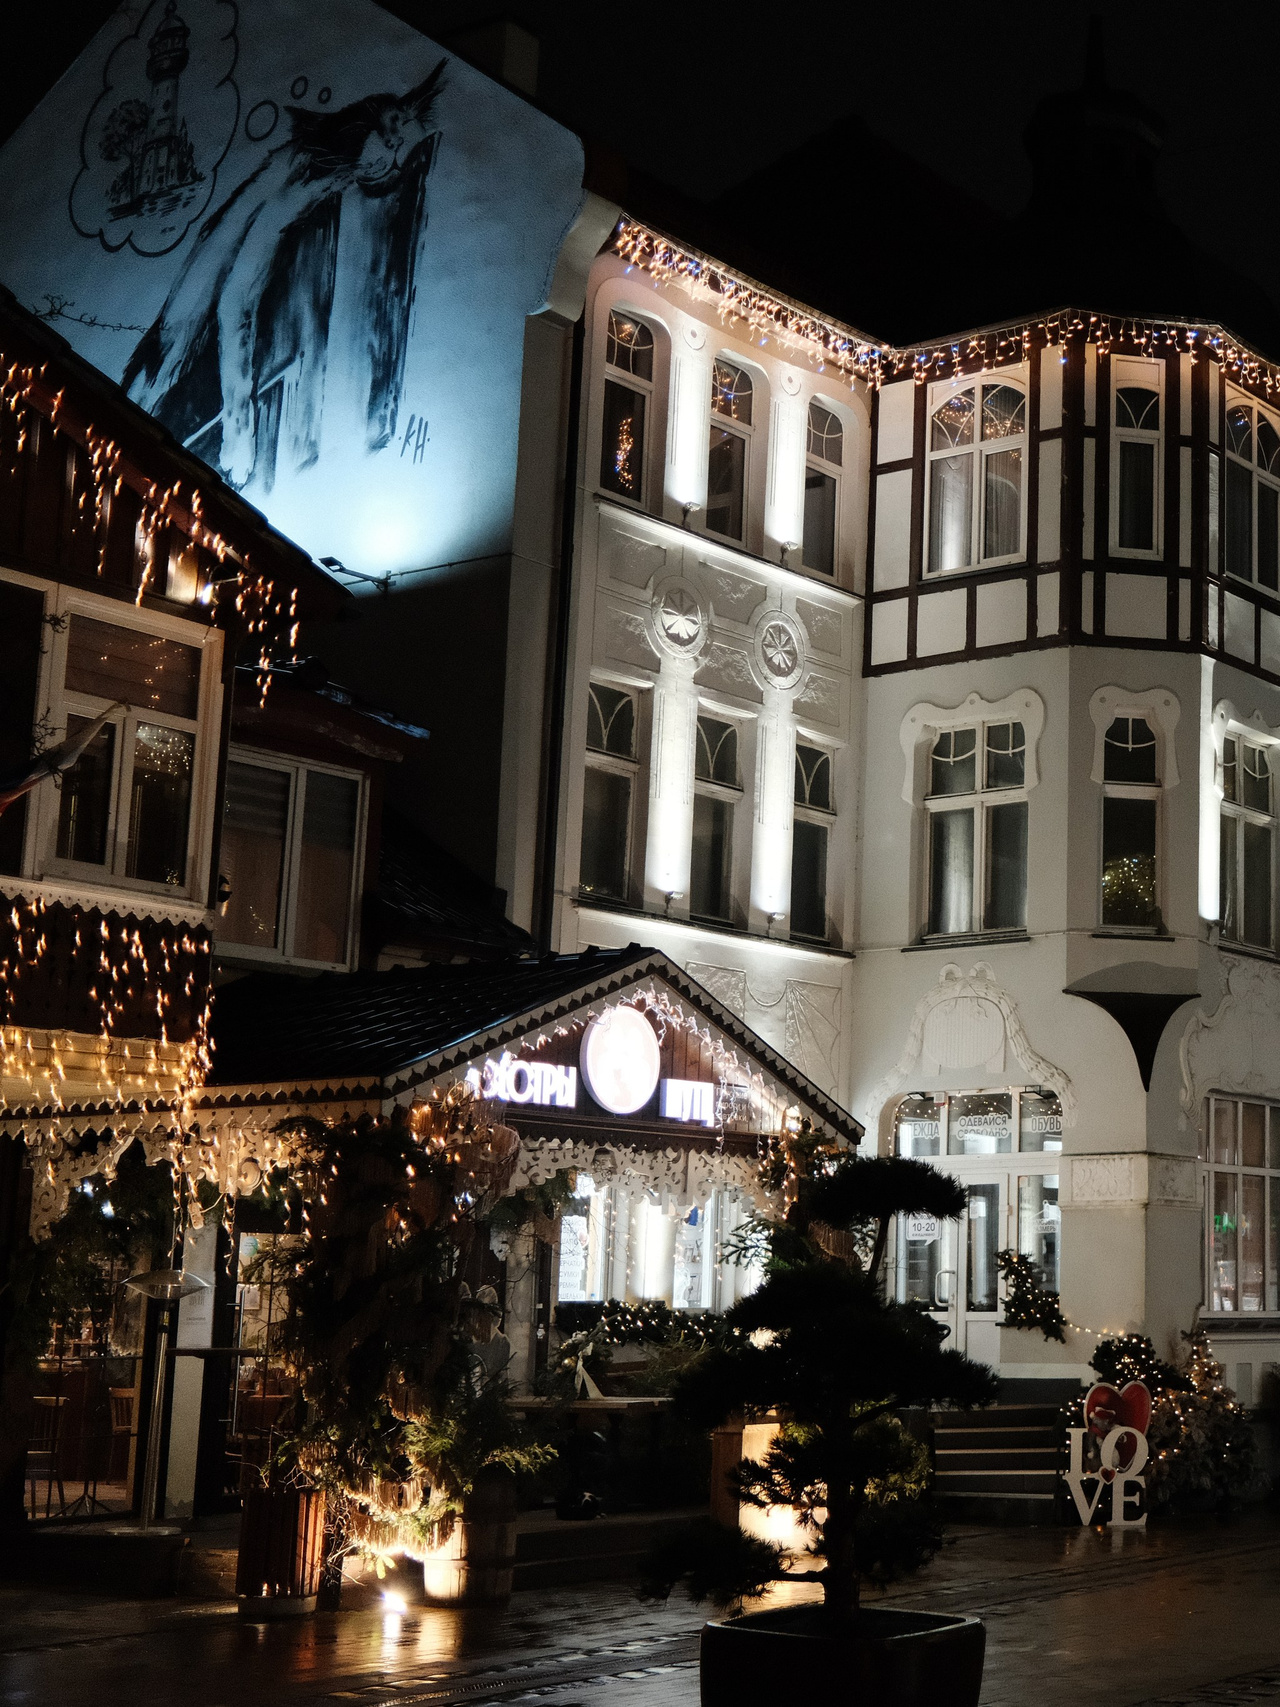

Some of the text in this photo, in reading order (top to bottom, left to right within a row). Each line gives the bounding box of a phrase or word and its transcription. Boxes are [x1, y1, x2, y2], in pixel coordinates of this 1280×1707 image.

[959, 1115, 1007, 1127] ОДЕВАЙСЯ
[1031, 1116, 1062, 1131] ОБУВЬ
[912, 1122, 940, 1136] ЕЖДА
[912, 1222, 936, 1232] 10-20
